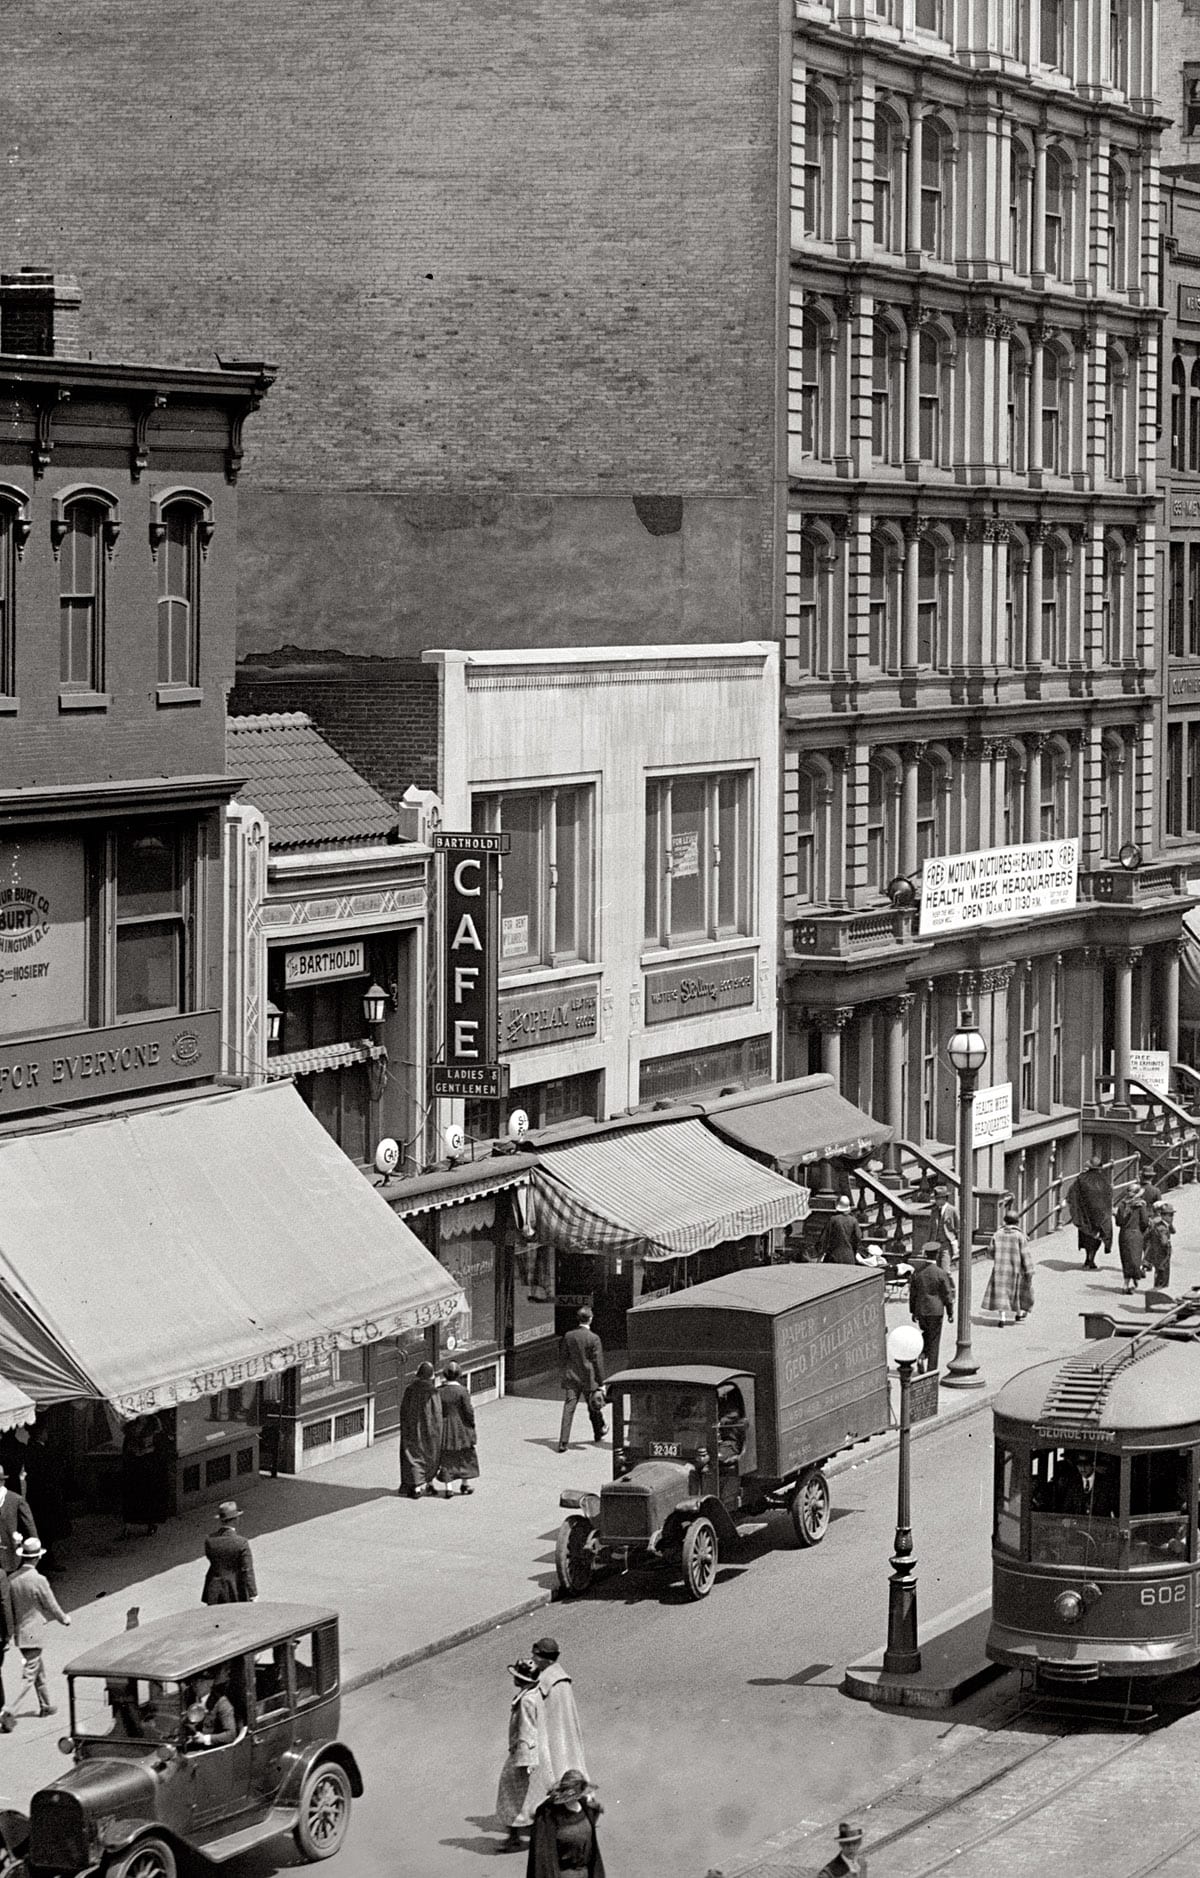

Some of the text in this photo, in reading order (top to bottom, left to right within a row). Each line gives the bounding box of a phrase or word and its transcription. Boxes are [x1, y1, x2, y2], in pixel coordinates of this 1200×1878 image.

[436, 837, 499, 849] BARTHOLDI
[927, 863, 945, 886] FREE
[948, 859, 976, 884] MOTION
[979, 853, 1012, 879] PICTURES
[1021, 849, 1054, 872] EXHIBITS
[1059, 845, 1075, 866] FREE
[15, 888, 37, 904] BURT
[925, 870, 1073, 909] HEALTH WEEK HEADQUARTERS
[962, 902, 982, 920] OPEN
[1004, 898, 1012, 911] TO
[515, 917, 526, 929] RENT
[299, 949, 361, 975] BARTHOLDI
[451, 858, 483, 1058] CAFE
[13, 962, 50, 981] HOSIERY
[0, 1062, 39, 1091] FOR
[52, 1042, 160, 1084] EVERYONE
[447, 1069, 484, 1080] LADIES
[435, 1082, 497, 1094] GENTLEMEN
[974, 1114, 1010, 1137] HEADQUARTERS
[559, 1296, 589, 1306] SALE
[781, 1318, 815, 1347] PAPER
[819, 1315, 861, 1360] KILLIAN
[189, 1350, 279, 1396] ARTHUR
[281, 1331, 341, 1364] BURT
[350, 1319, 383, 1345] CO.
[415, 1299, 459, 1326] 1343
[845, 1341, 879, 1368] BOXES
[1140, 1584, 1186, 1606] 602
